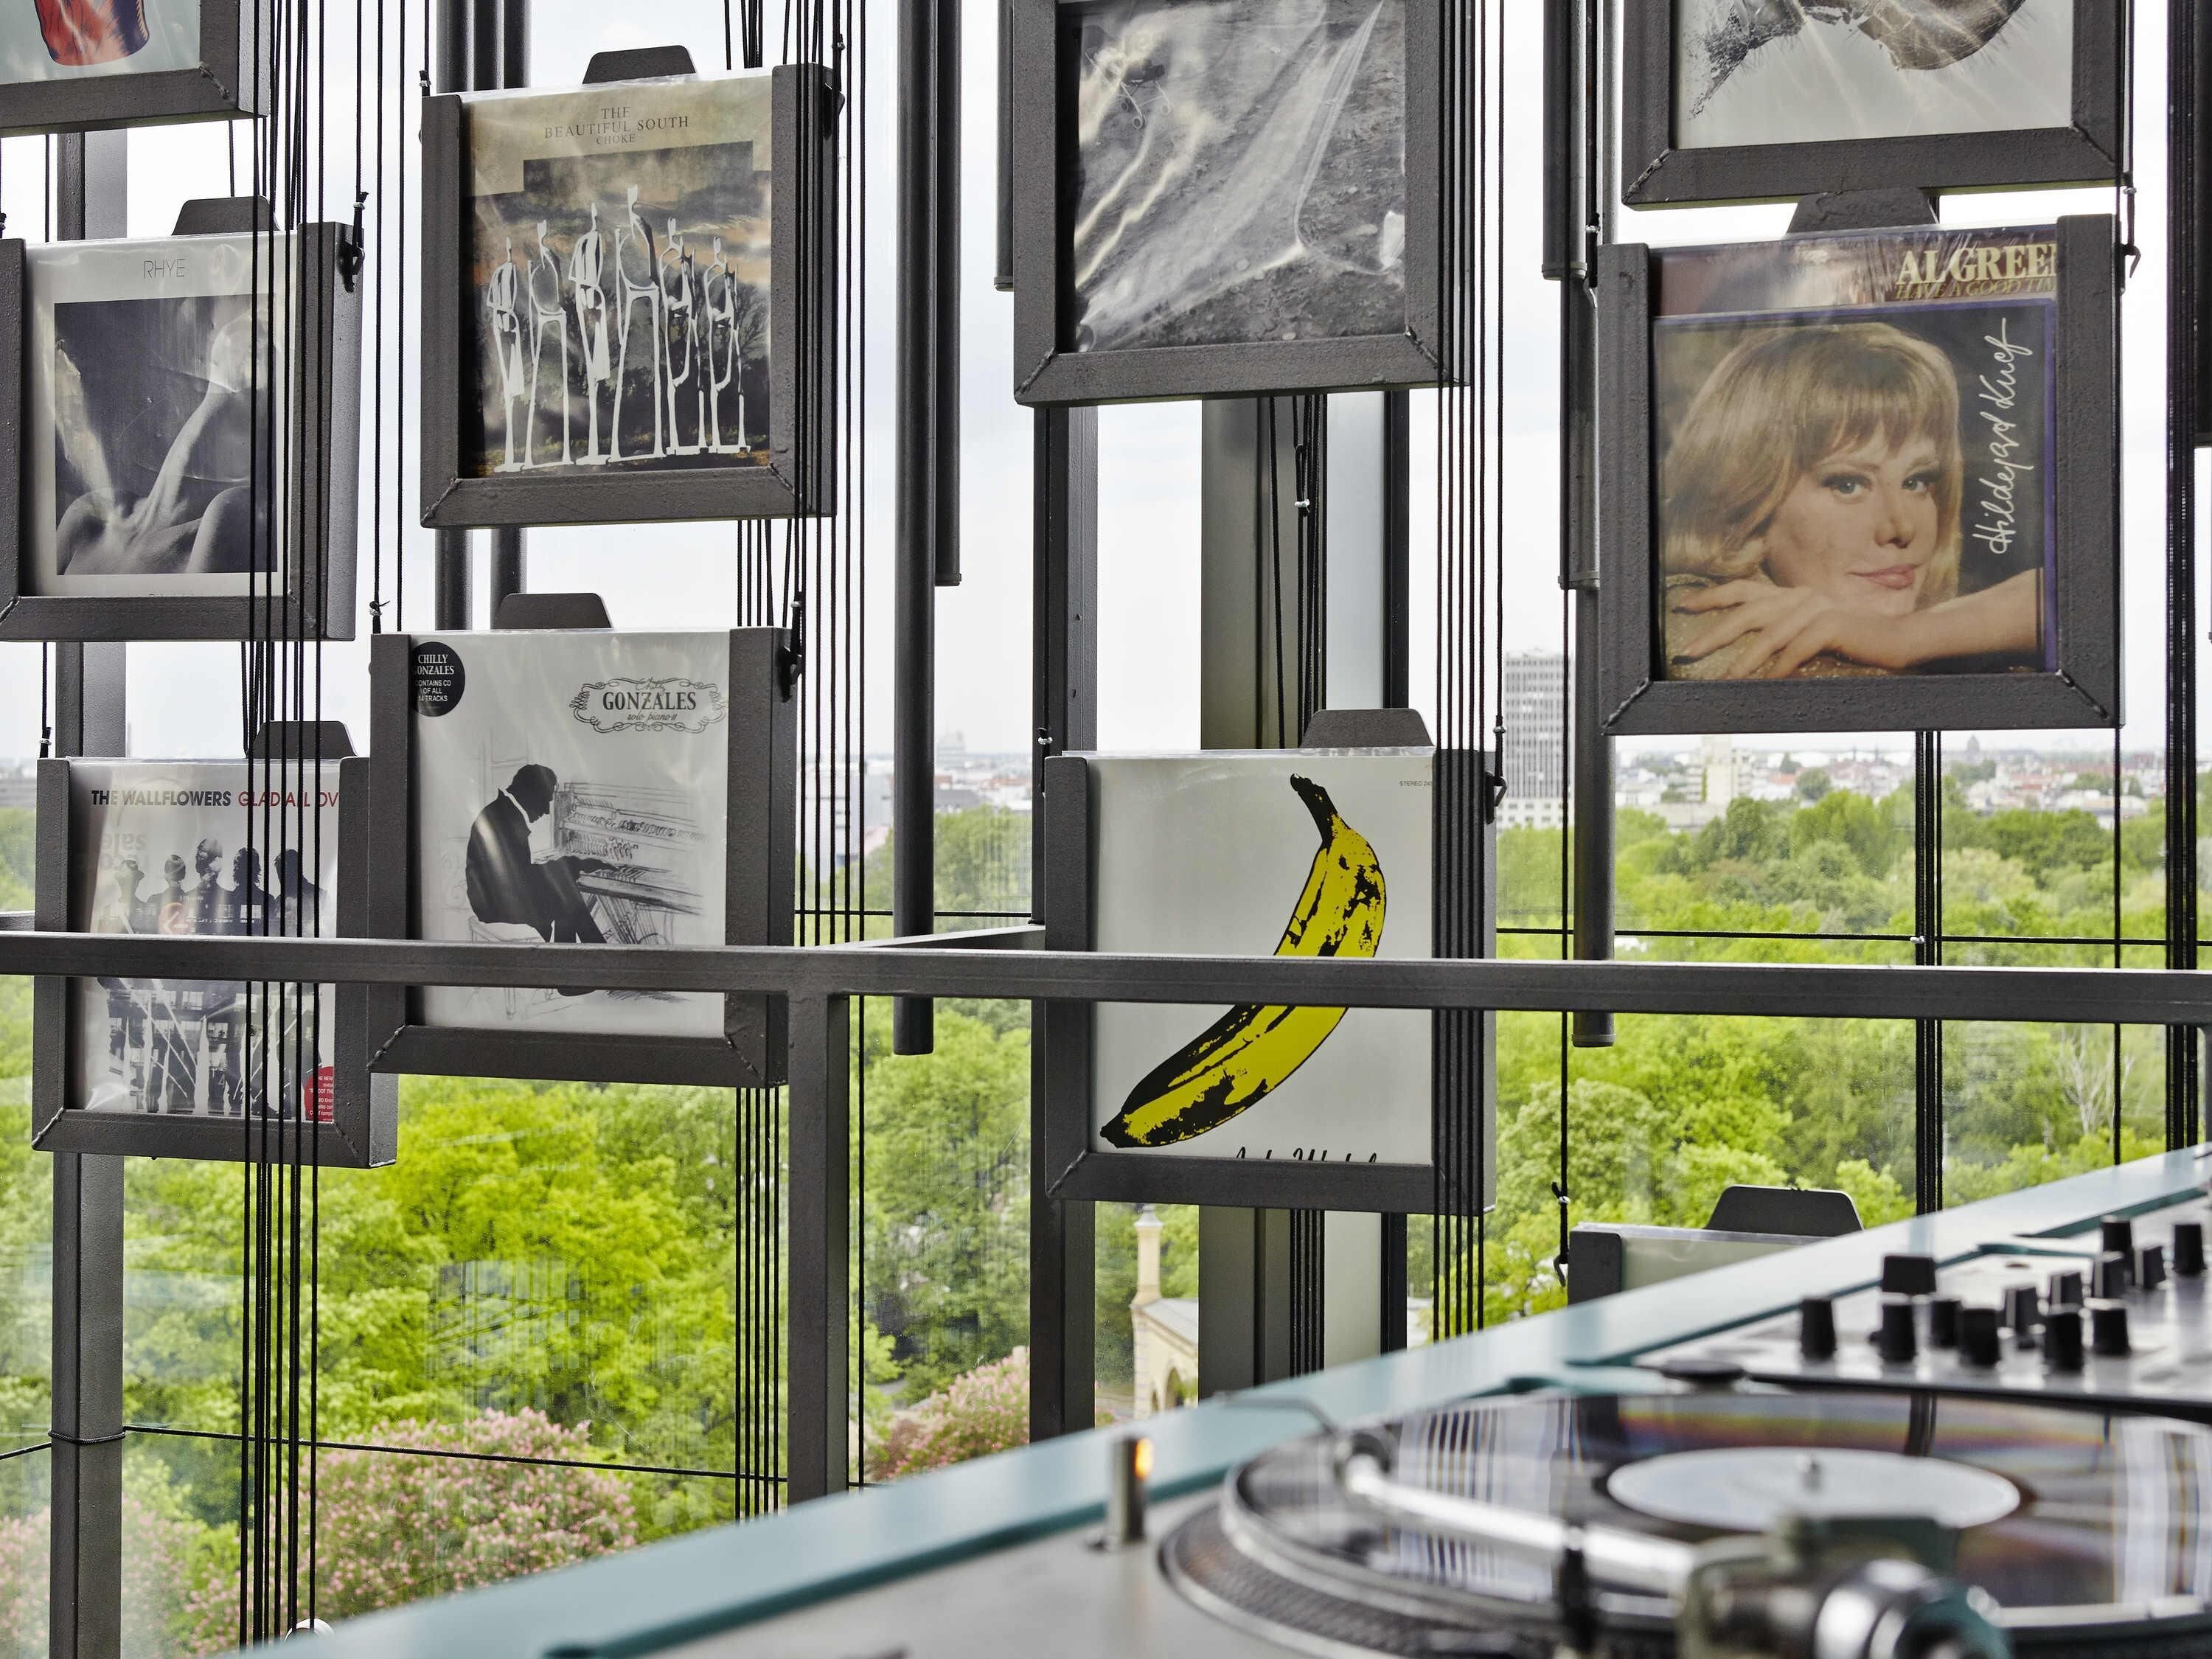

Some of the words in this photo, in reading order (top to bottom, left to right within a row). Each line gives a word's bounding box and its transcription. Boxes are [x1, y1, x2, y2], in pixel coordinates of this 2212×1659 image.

[602, 107, 631, 119] THE
[545, 121, 631, 139] BEAUTIFUL
[637, 116, 688, 131] SOUTH
[596, 133, 636, 145] CHOKE
[144, 258, 185, 279] RHYE
[1896, 250, 1946, 285] AL
[1966, 279, 2021, 296] GOOD
[418, 654, 448, 664] CHILLY
[417, 665, 454, 675] ONZALES
[602, 692, 697, 711] GONZALES
[91, 790, 118, 805] THE
[122, 790, 231, 807] WALLFLOWERS
[238, 791, 281, 807] GLAD
[285, 791, 310, 807] AL
[319, 791, 338, 808] OV
